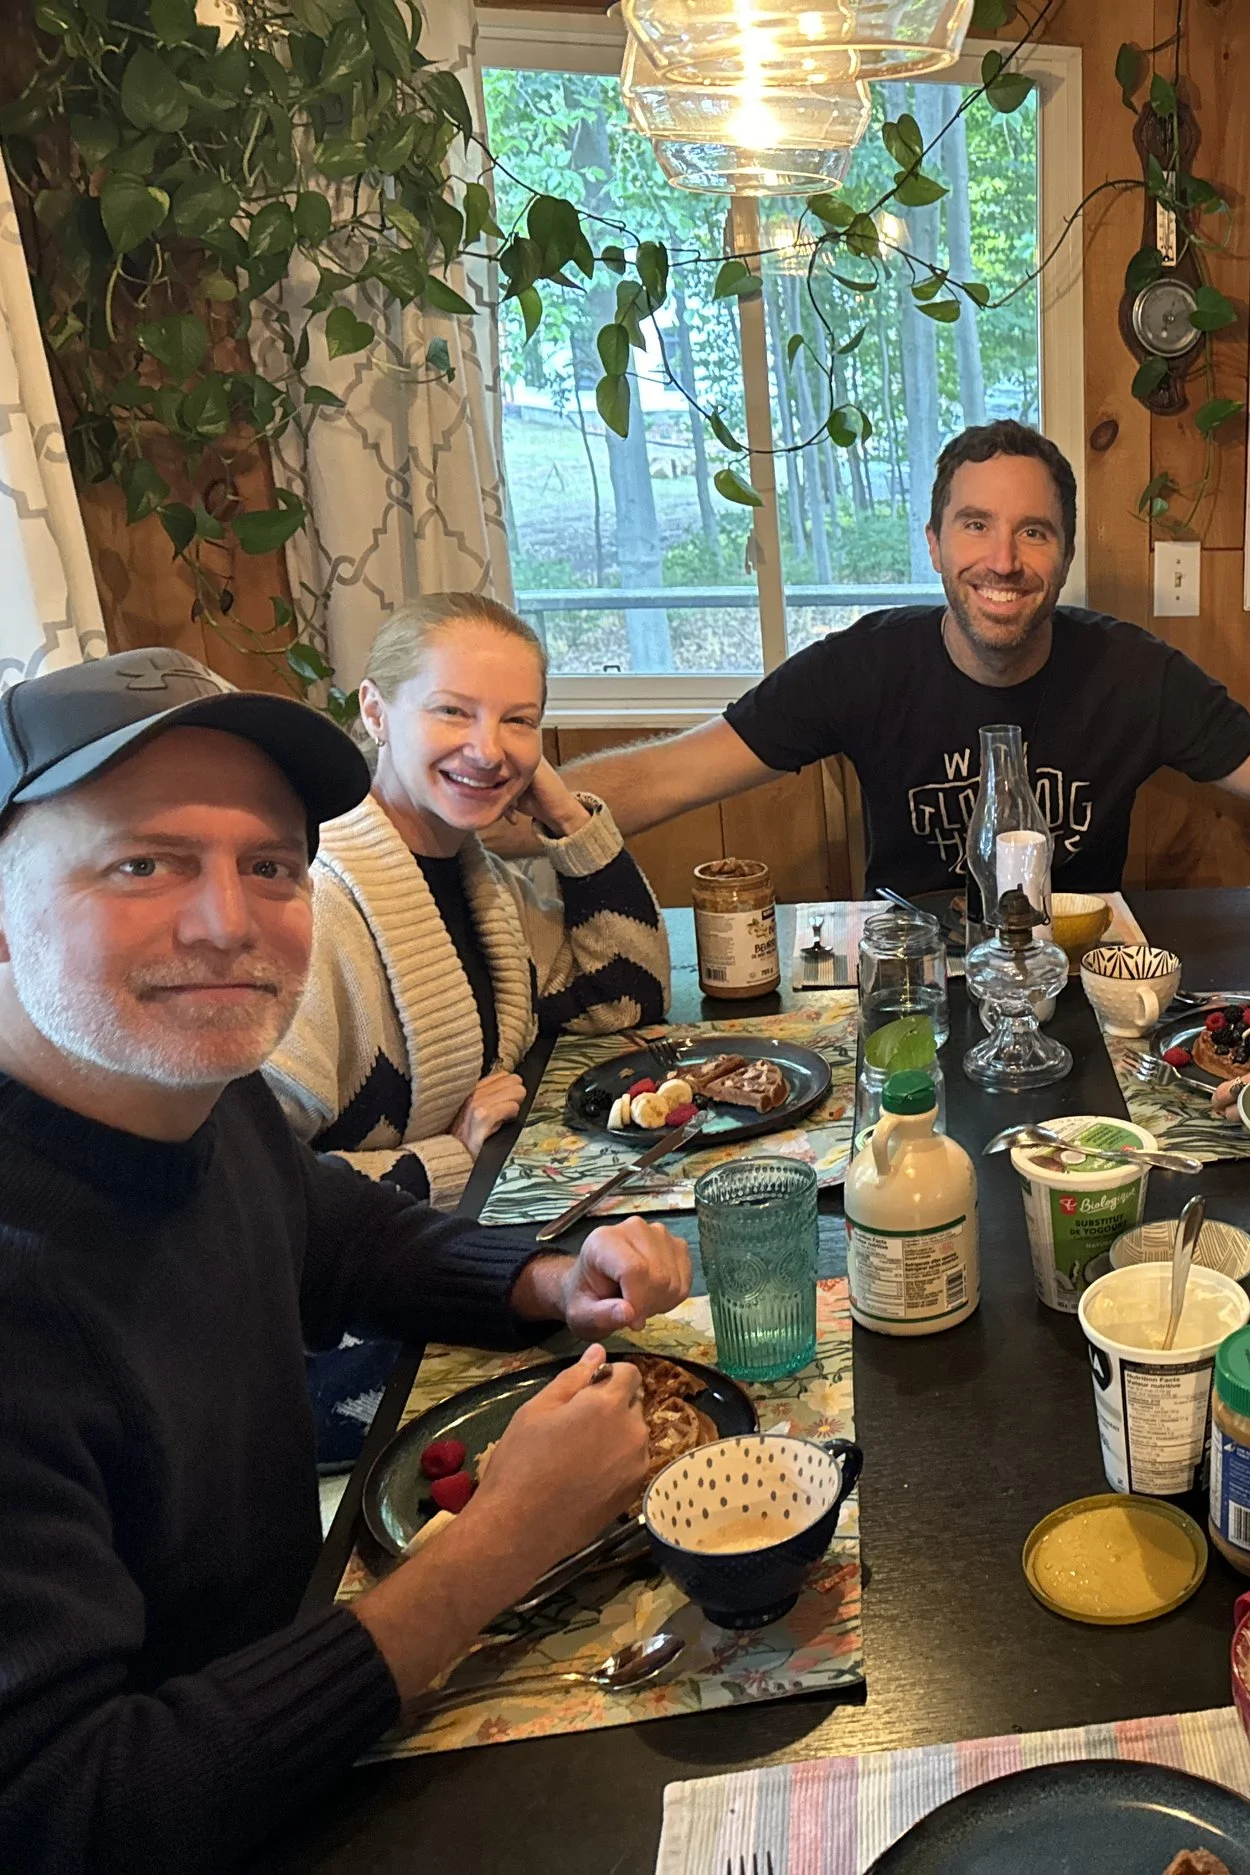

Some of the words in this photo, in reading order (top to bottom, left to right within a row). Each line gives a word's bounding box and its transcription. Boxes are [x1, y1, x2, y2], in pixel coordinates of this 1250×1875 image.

[1079, 1187, 1136, 1214] Biologique
[1070, 1228, 1081, 1236] DE
[1084, 1220, 1128, 1236] YOGOURT
[1075, 1214, 1124, 1228] SUBSTITUT
[1126, 1373, 1158, 1383] Nutrition
[1126, 1379, 1149, 1388] Valeur
